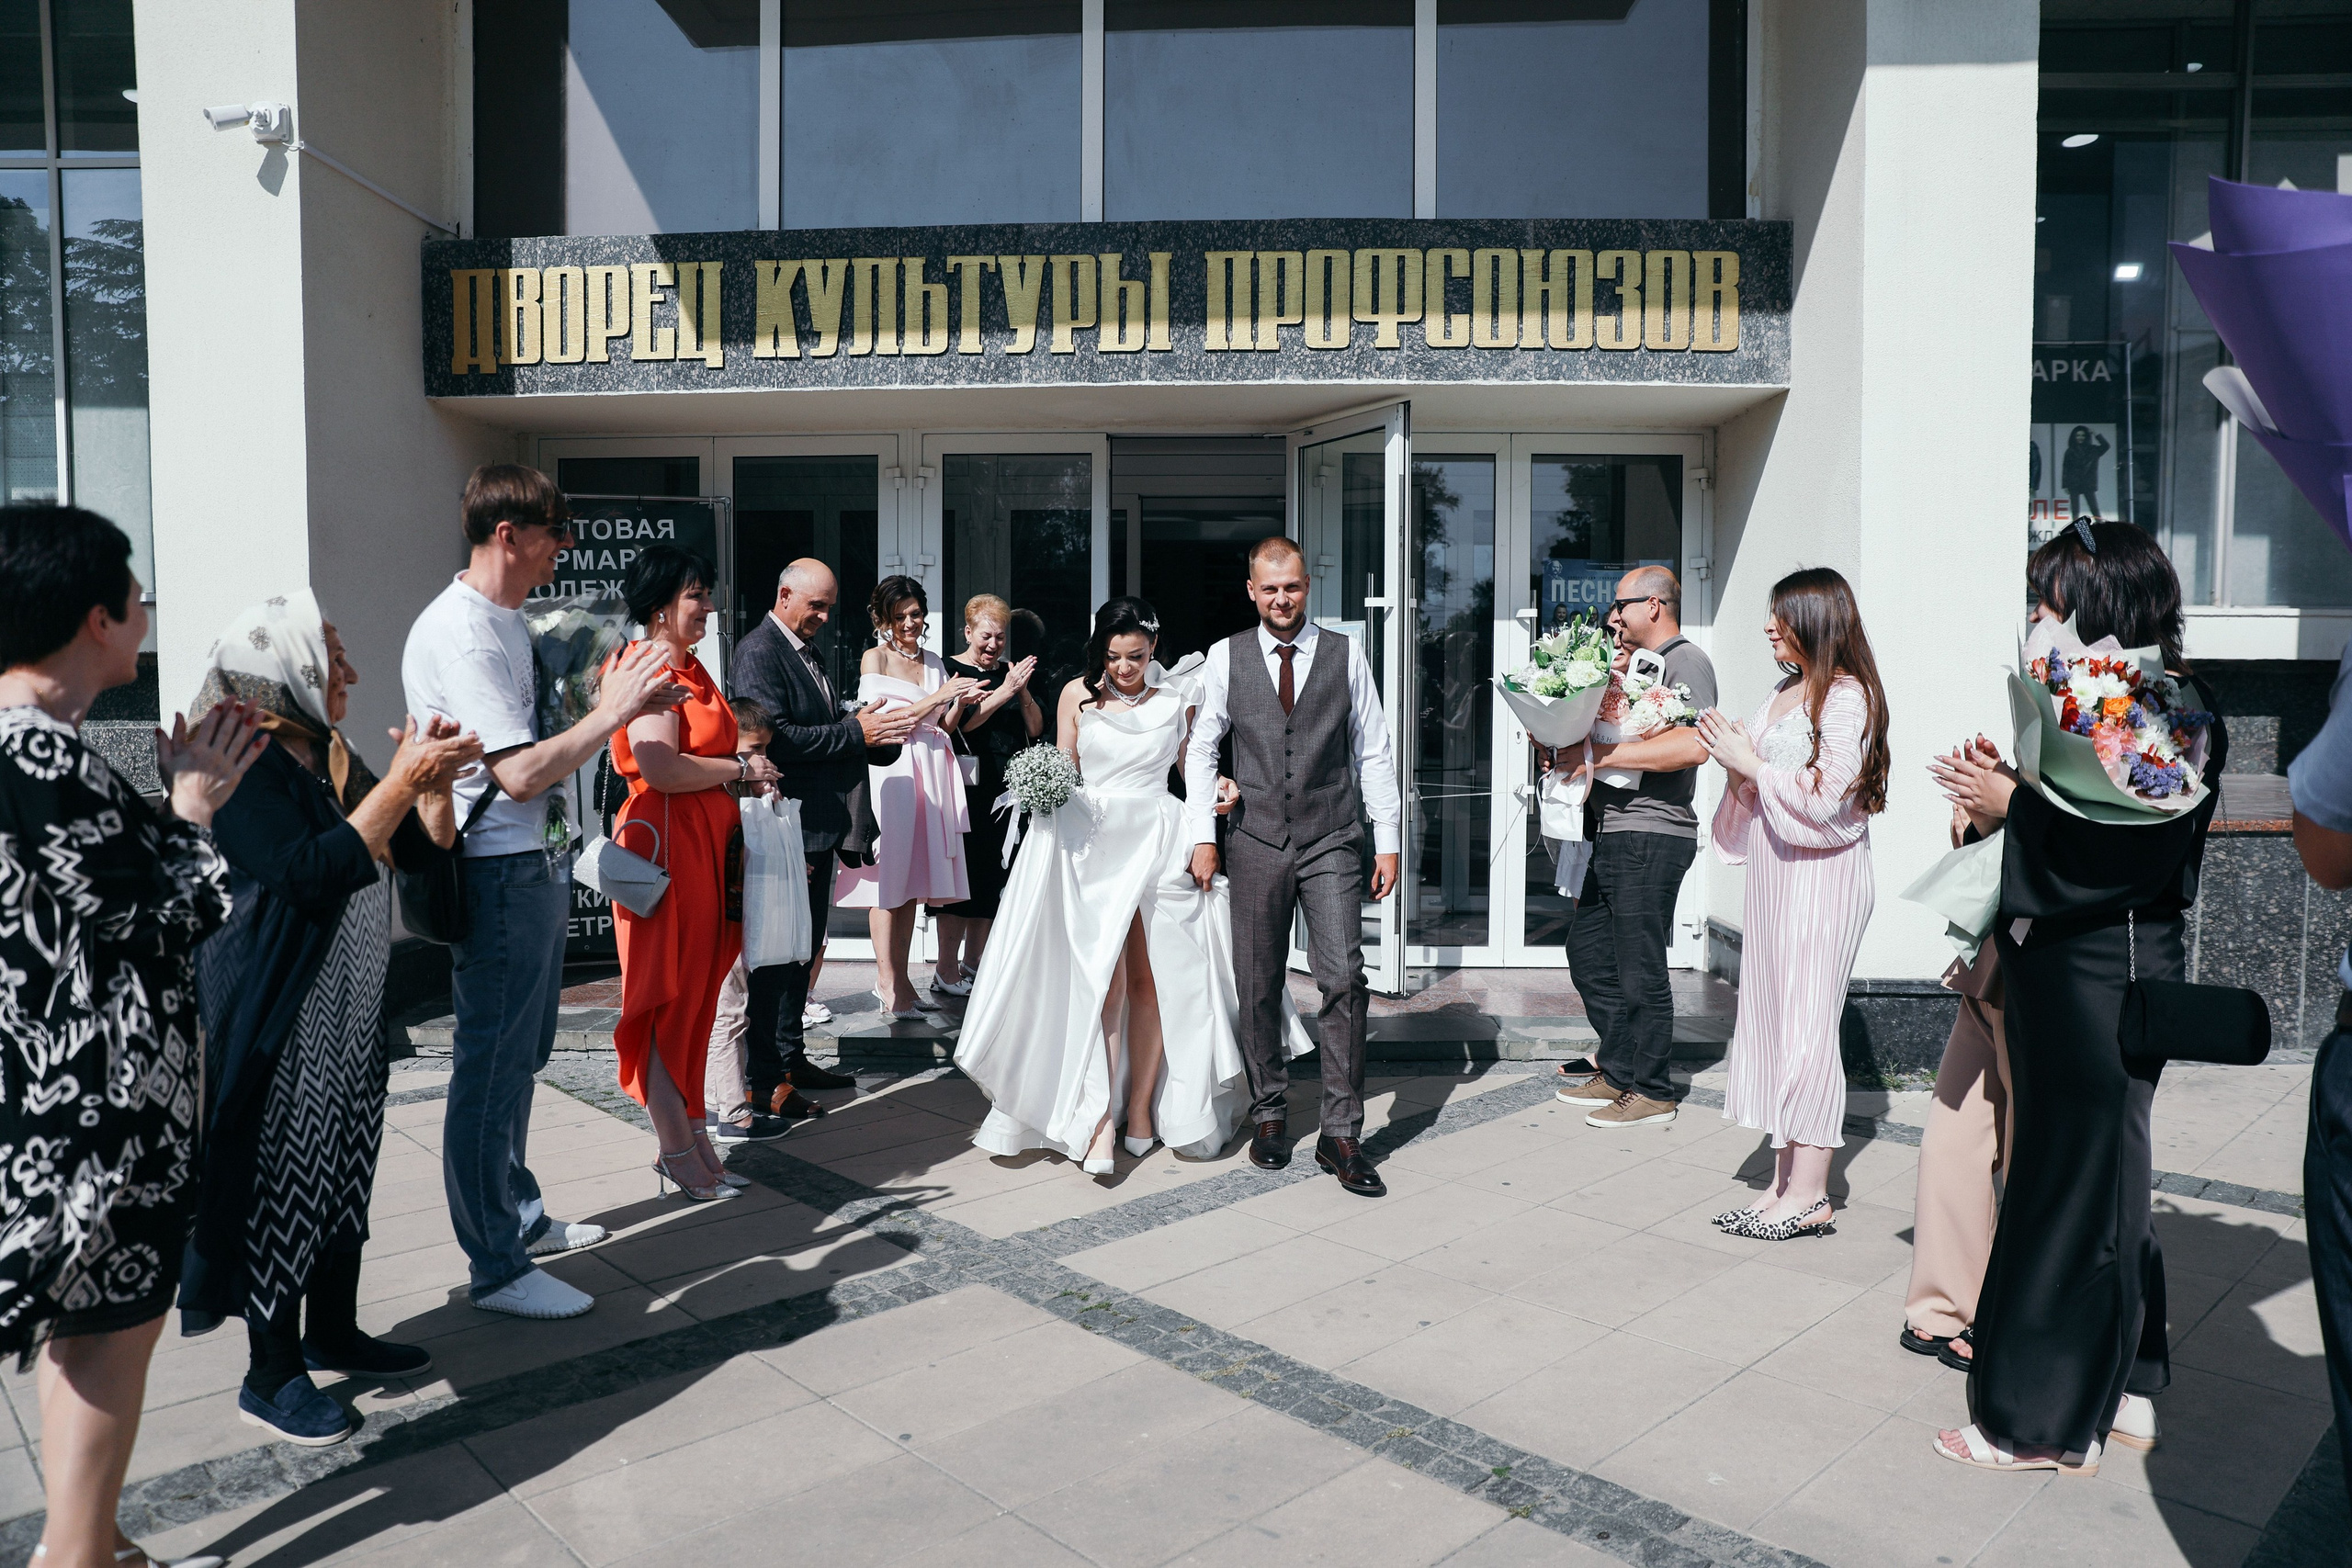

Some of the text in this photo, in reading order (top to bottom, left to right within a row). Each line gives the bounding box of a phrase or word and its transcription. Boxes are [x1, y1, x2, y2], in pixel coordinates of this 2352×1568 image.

[450, 247, 1741, 375] ДВОРЕЦ КУЛЬТУРЫ ПРОФСОЮЗОВ
[2032, 359, 2112, 382] АРКА
[2032, 499, 2070, 520] ЛЕ
[572, 519, 675, 540] ТОВАЯ
[2029, 529, 2061, 542] ЖД
[554, 549, 638, 570] РМАР
[535, 580, 626, 601] ОДЕЖ
[1551, 579, 1618, 604] ПЕСН
[567, 916, 613, 938] ЕТР
